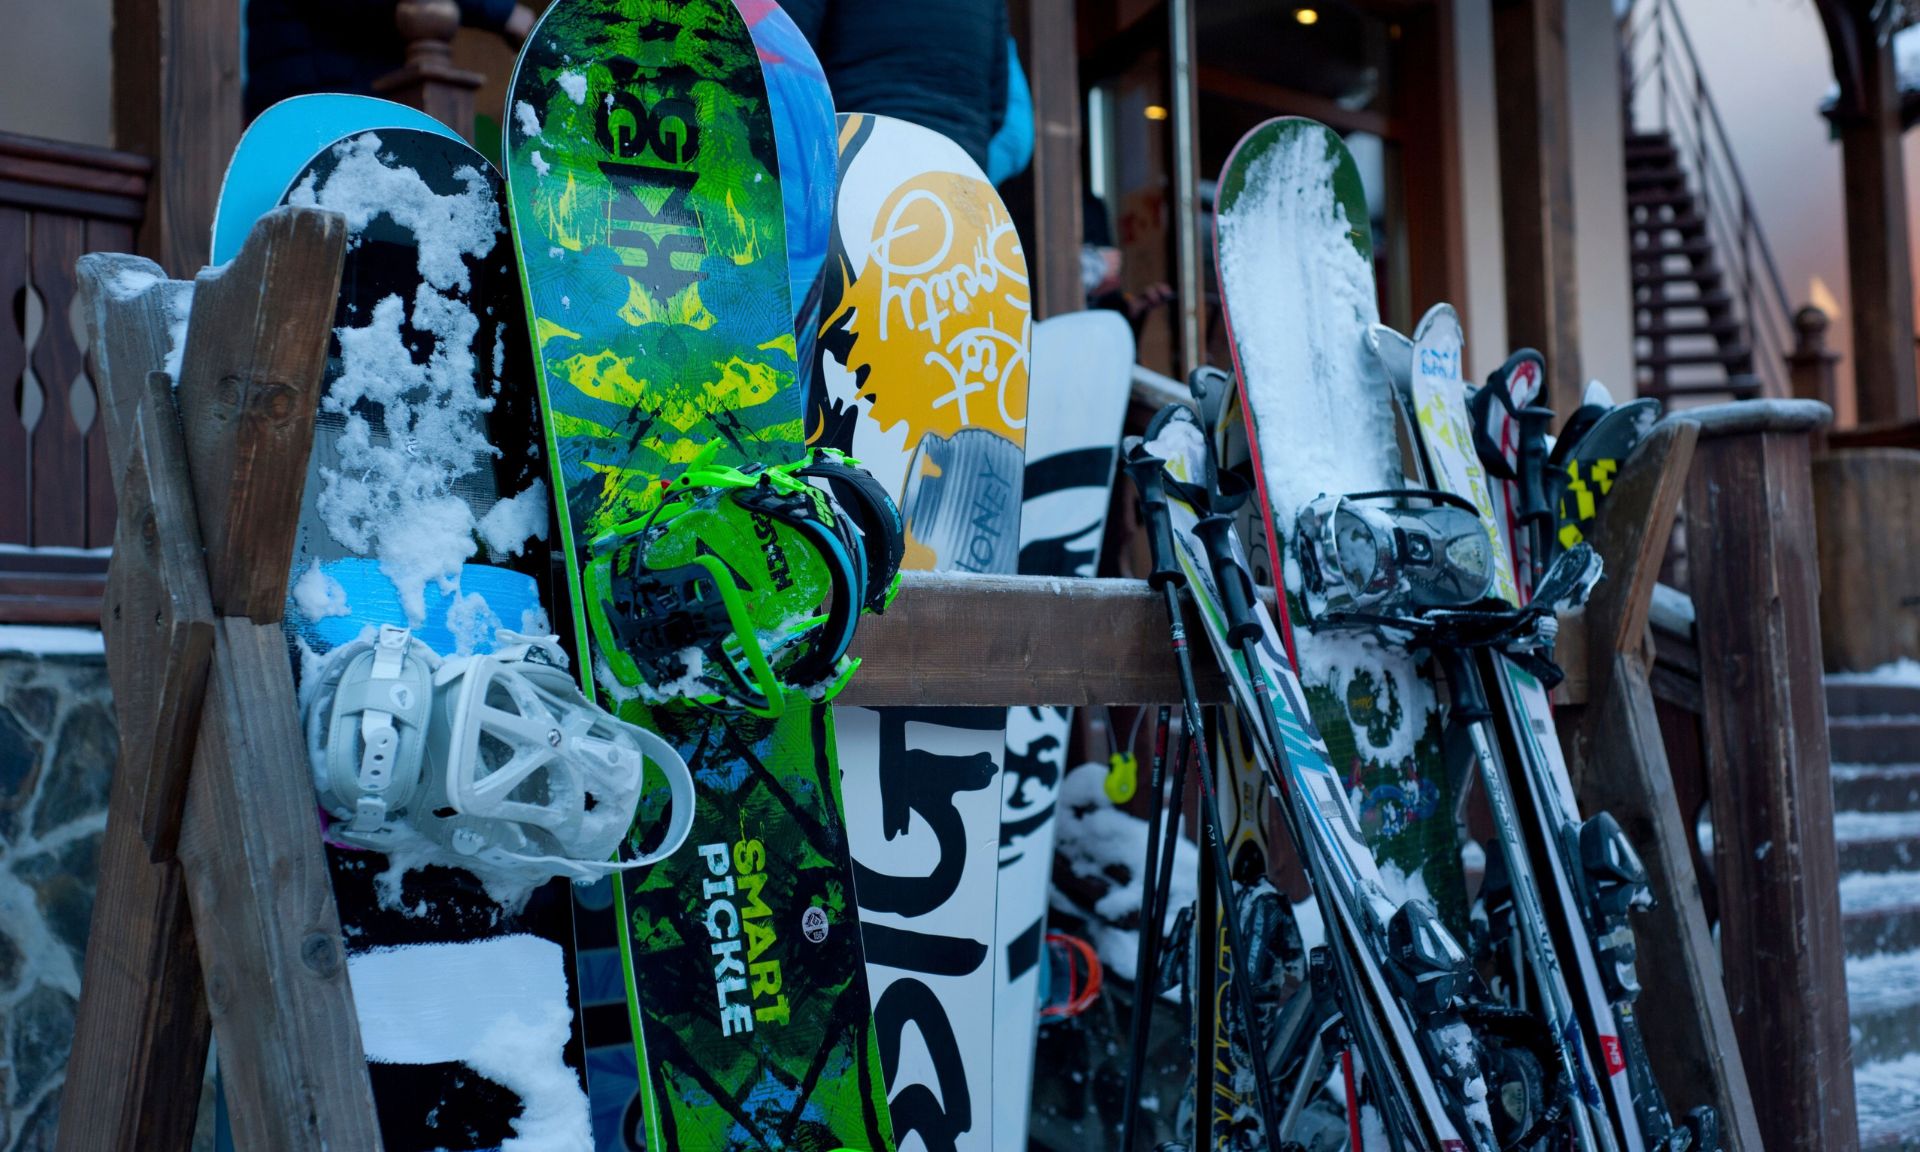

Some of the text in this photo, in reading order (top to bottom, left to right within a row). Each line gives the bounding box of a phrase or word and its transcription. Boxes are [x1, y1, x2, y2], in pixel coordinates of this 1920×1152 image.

[868, 189, 1031, 345] Society
[923, 312, 1031, 430] Riot
[955, 451, 1011, 573] ONEY
[698, 842, 754, 1038] PICKLE
[733, 839, 790, 1026] SMART
